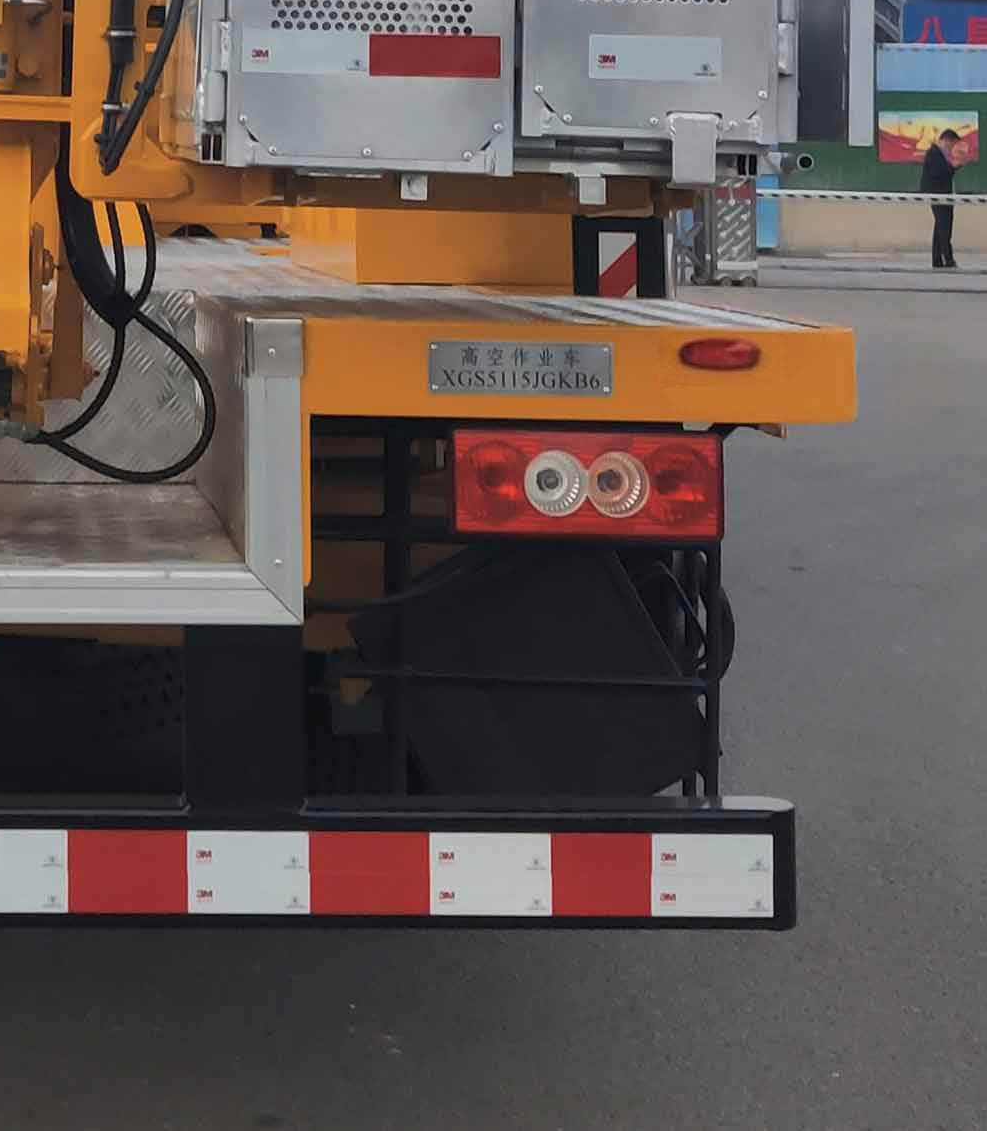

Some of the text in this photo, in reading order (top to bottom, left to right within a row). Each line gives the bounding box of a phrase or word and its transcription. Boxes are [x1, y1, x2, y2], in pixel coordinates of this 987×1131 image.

[462, 345, 580, 368] 高空作业车
[443, 369, 600, 390] XGS5115JGKB6
